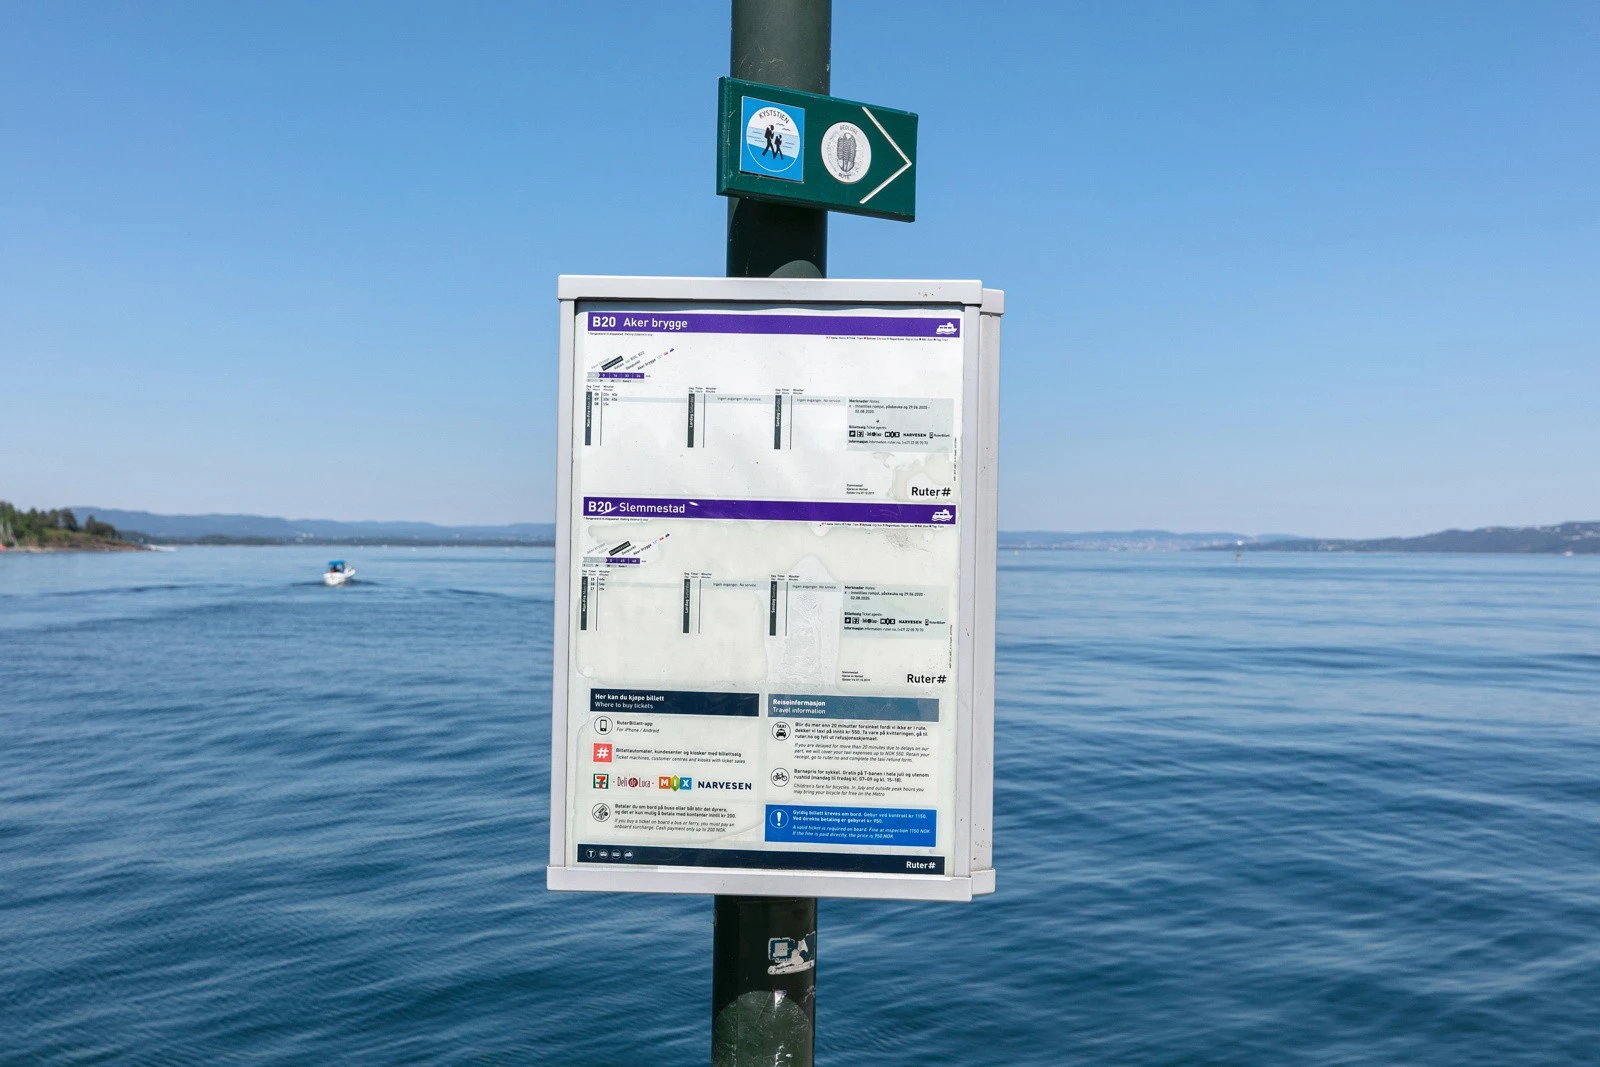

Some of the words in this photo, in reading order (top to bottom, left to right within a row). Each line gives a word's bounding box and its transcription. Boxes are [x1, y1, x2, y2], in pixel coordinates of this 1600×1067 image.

[758, 110, 789, 124] KYSTSTIEN
[592, 316, 616, 327] B20
[624, 318, 649, 327] Aker
[652, 318, 688, 330] brygge
[588, 501, 612, 512] B20
[620, 502, 685, 513] Slemmestad
[773, 699, 826, 708] Reiseinformasjon
[617, 777, 628, 787] Deli
[639, 778, 650, 788] Luca
[660, 779, 690, 788] MIX
[698, 781, 752, 790] NARVESEN
